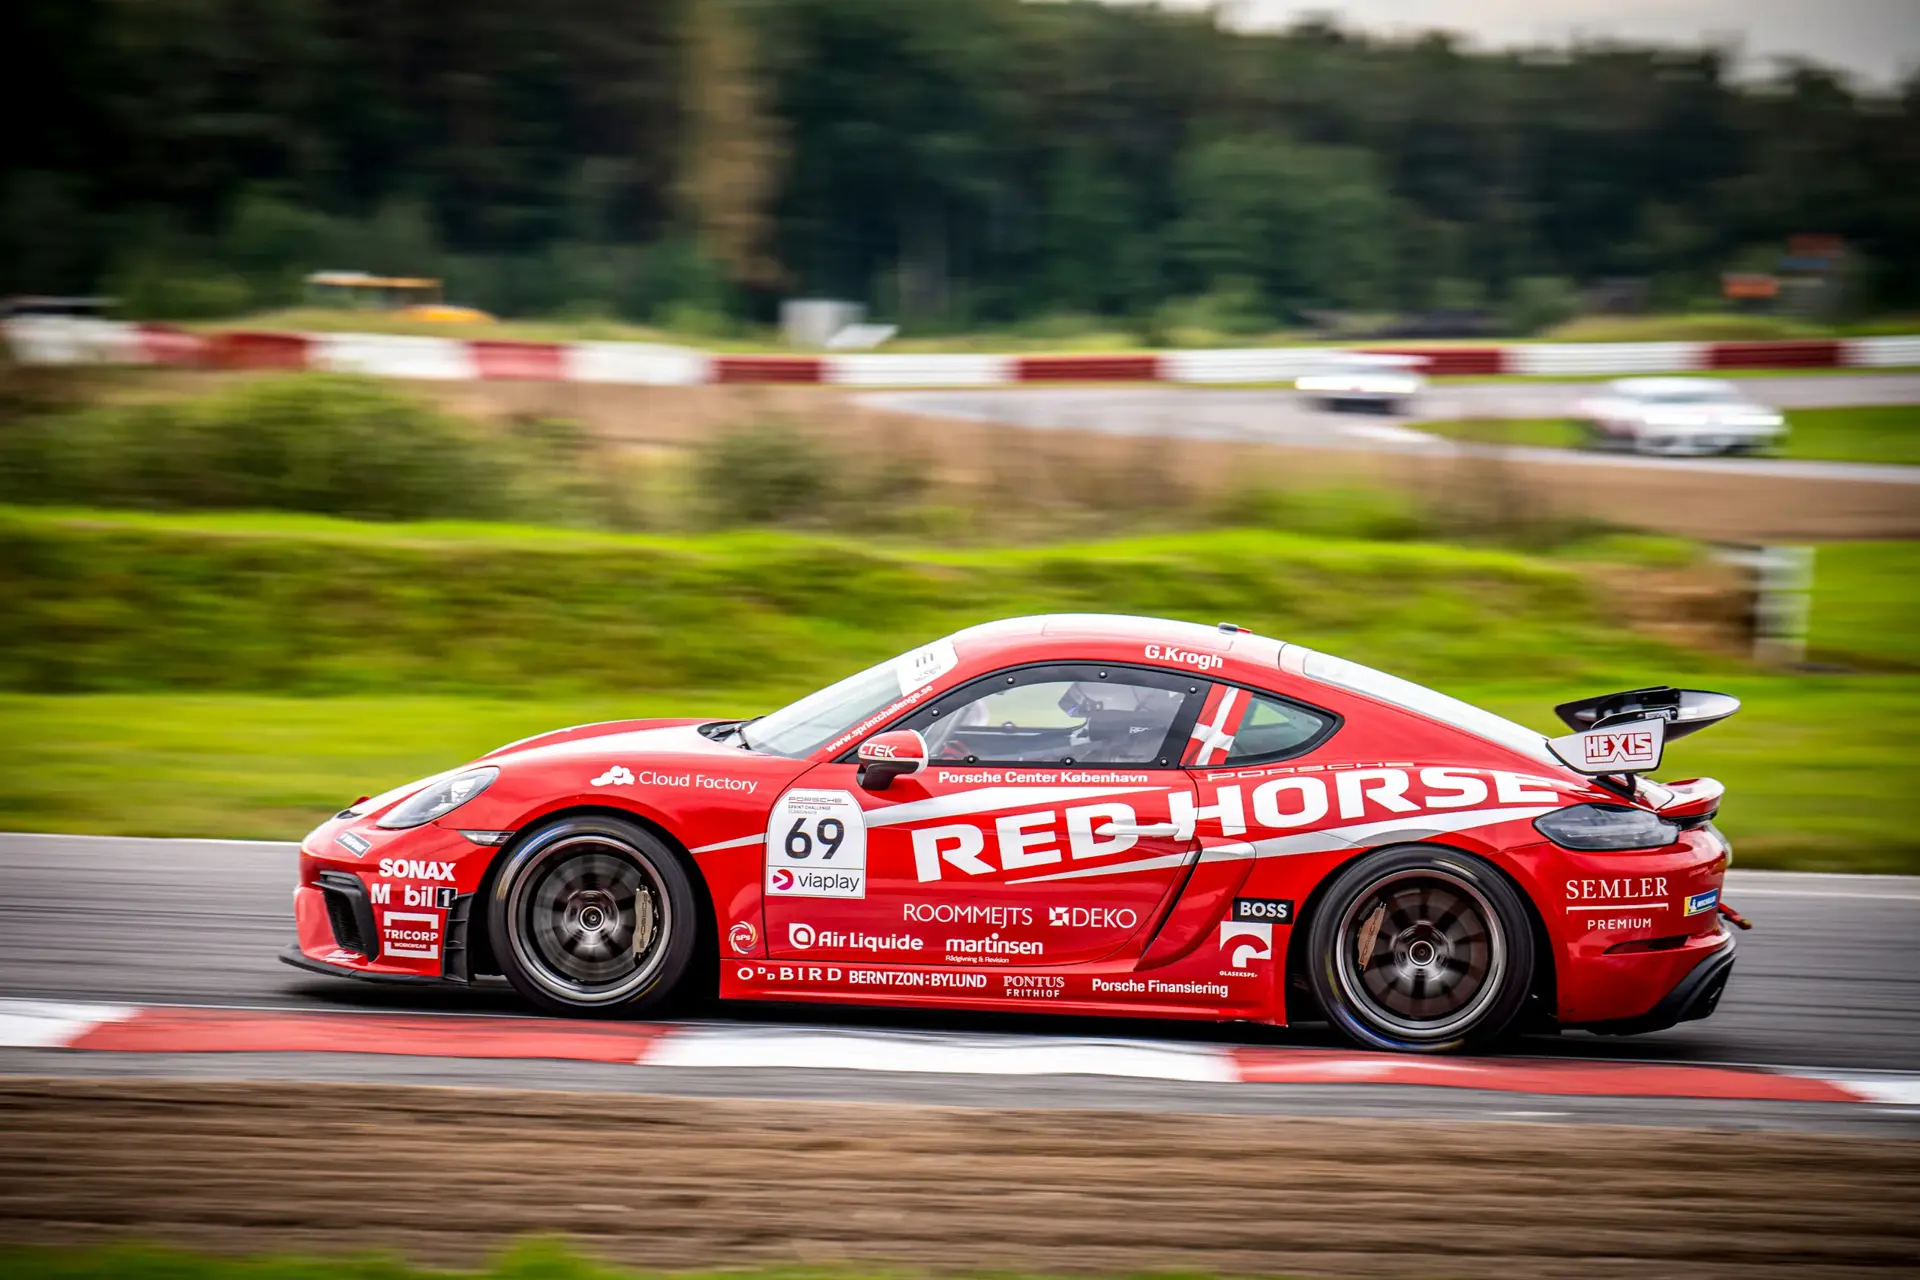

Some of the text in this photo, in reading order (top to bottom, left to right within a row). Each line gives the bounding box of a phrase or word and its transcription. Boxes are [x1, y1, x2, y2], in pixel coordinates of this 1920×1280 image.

[1144, 644, 1224, 670] G.Krogh
[826, 685, 934, 753] www.sprintchallenge.se
[859, 742, 898, 758] CTEK
[1584, 731, 1653, 764] HEXIS
[638, 771, 759, 794] Cloud Factory
[938, 771, 1149, 784] Porsche Center København
[1207, 762, 1415, 782] PORSCHE
[1168, 767, 1559, 842] HORSE
[784, 817, 845, 860] 69
[911, 803, 1138, 883] RED
[379, 858, 457, 881] SONAX
[798, 873, 860, 892] viaplay
[1566, 876, 1669, 900] SEMLER
[371, 883, 433, 908] Mbil
[903, 903, 1137, 929] ROOMMEJTS DEKO
[1240, 901, 1288, 918] BOSS
[1587, 918, 1652, 930] PREMIUM
[383, 929, 439, 942] TRICORP
[818, 931, 924, 952] Air Liquide
[945, 932, 1043, 954] martinsen
[1003, 975, 1065, 988] PONTUS
[1092, 978, 1228, 998] Porsche Finansiering
[1006, 988, 1060, 998] FRITHIOF
